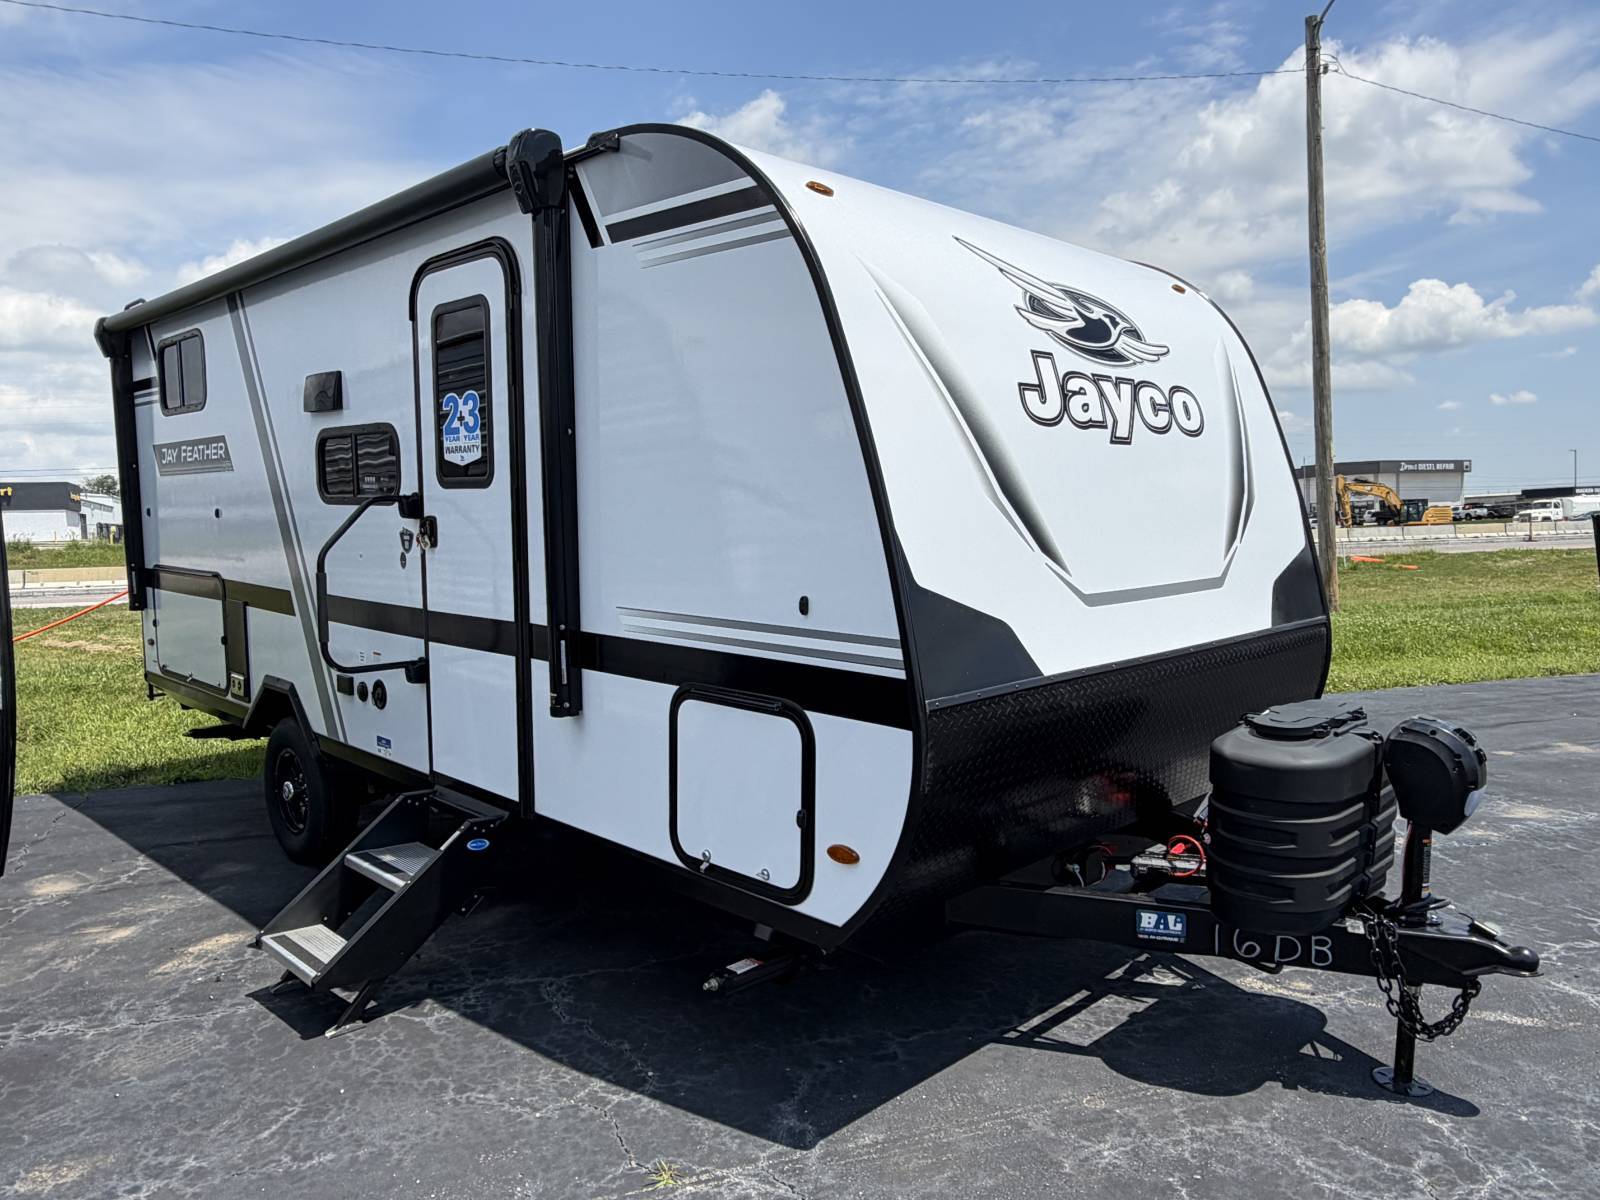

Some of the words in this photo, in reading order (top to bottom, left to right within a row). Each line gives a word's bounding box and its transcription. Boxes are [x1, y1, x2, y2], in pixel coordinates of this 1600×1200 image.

[1018, 350, 1204, 445] Jayco
[161, 448, 178, 464] JAY
[180, 443, 226, 462] FEATHER
[445, 444, 480, 454] WARRANTY
[1140, 912, 1183, 931] BAL
